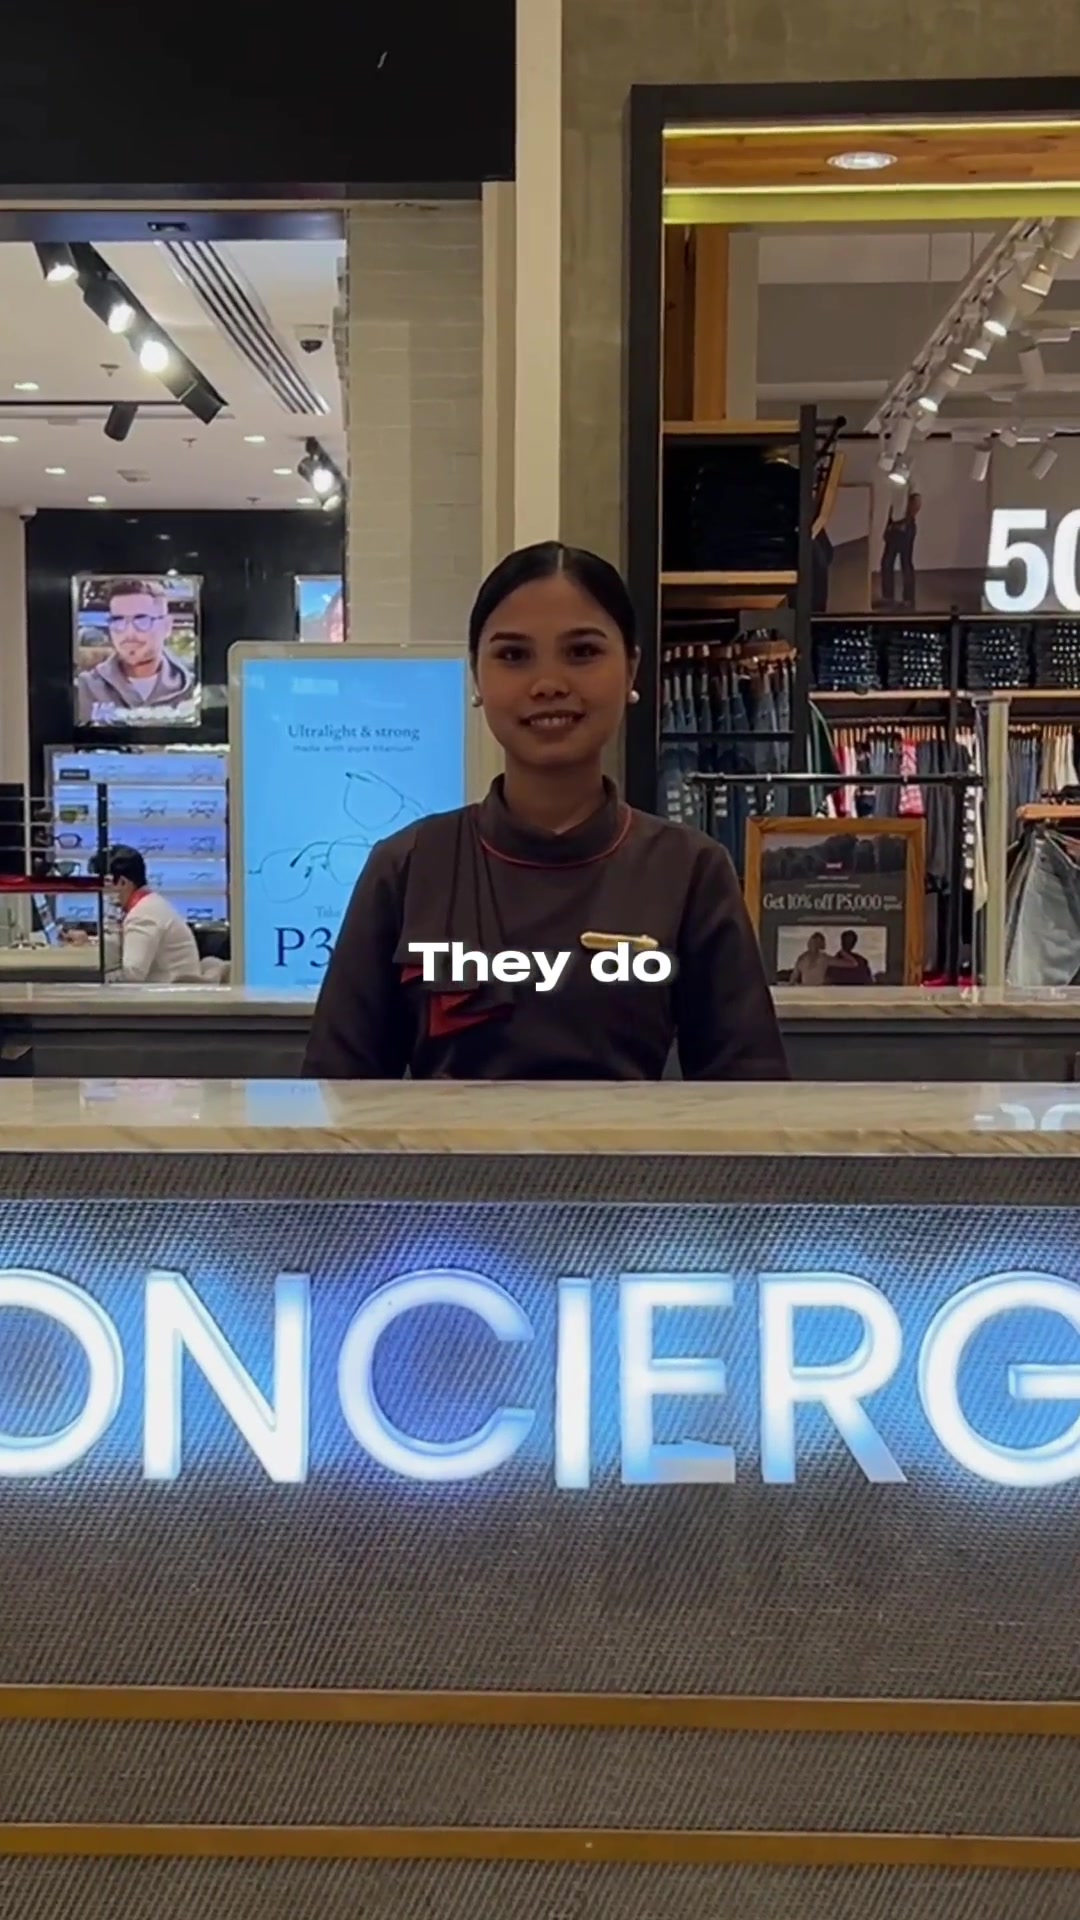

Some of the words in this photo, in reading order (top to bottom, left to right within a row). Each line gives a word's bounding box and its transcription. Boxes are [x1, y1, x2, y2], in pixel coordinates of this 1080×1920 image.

[288, 723, 357, 741] Ultralight
[360, 725, 371, 738] &
[375, 727, 421, 742] strong
[763, 893, 785, 910] Get
[788, 893, 813, 910] 10%
[814, 892, 834, 910] off
